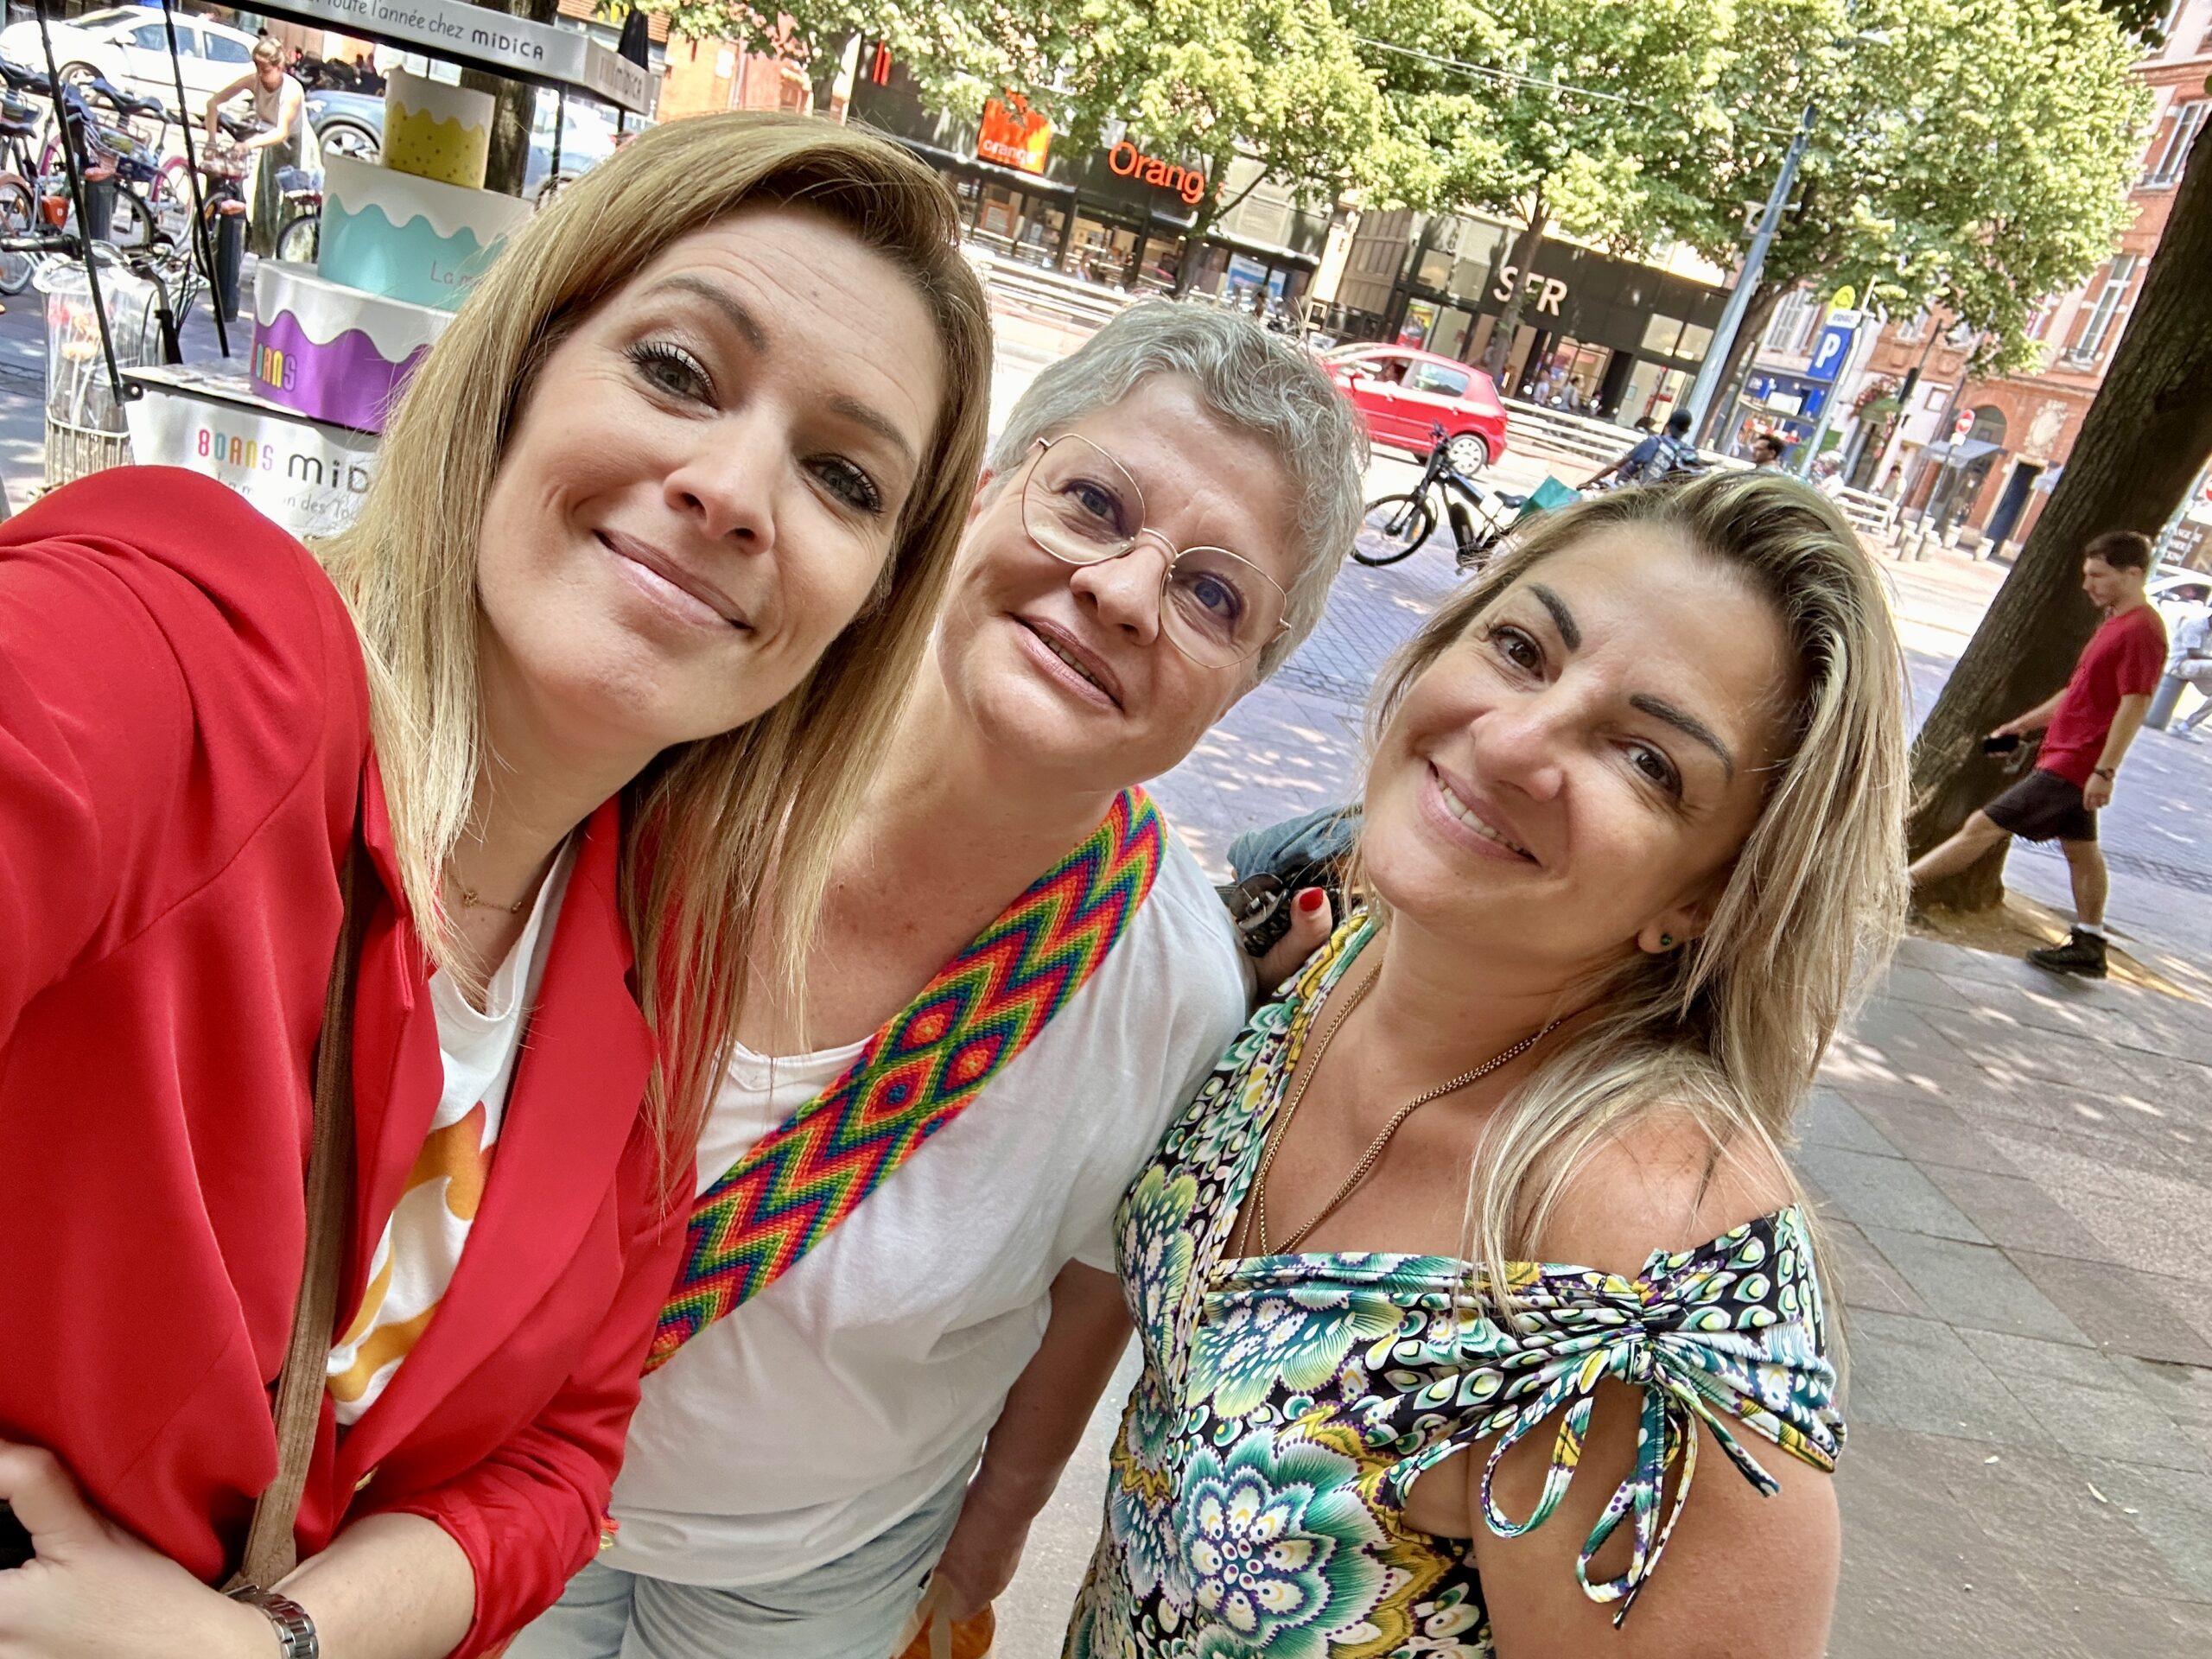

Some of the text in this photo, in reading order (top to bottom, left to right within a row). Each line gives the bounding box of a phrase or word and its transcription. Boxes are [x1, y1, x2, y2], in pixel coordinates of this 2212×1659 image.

[429, 12, 465, 39] chez
[1108, 140, 1206, 205] Orang
[430, 260, 454, 284] La
[1492, 265, 1567, 317] SFR
[1815, 332, 1842, 369] P
[287, 453, 369, 494] miD
